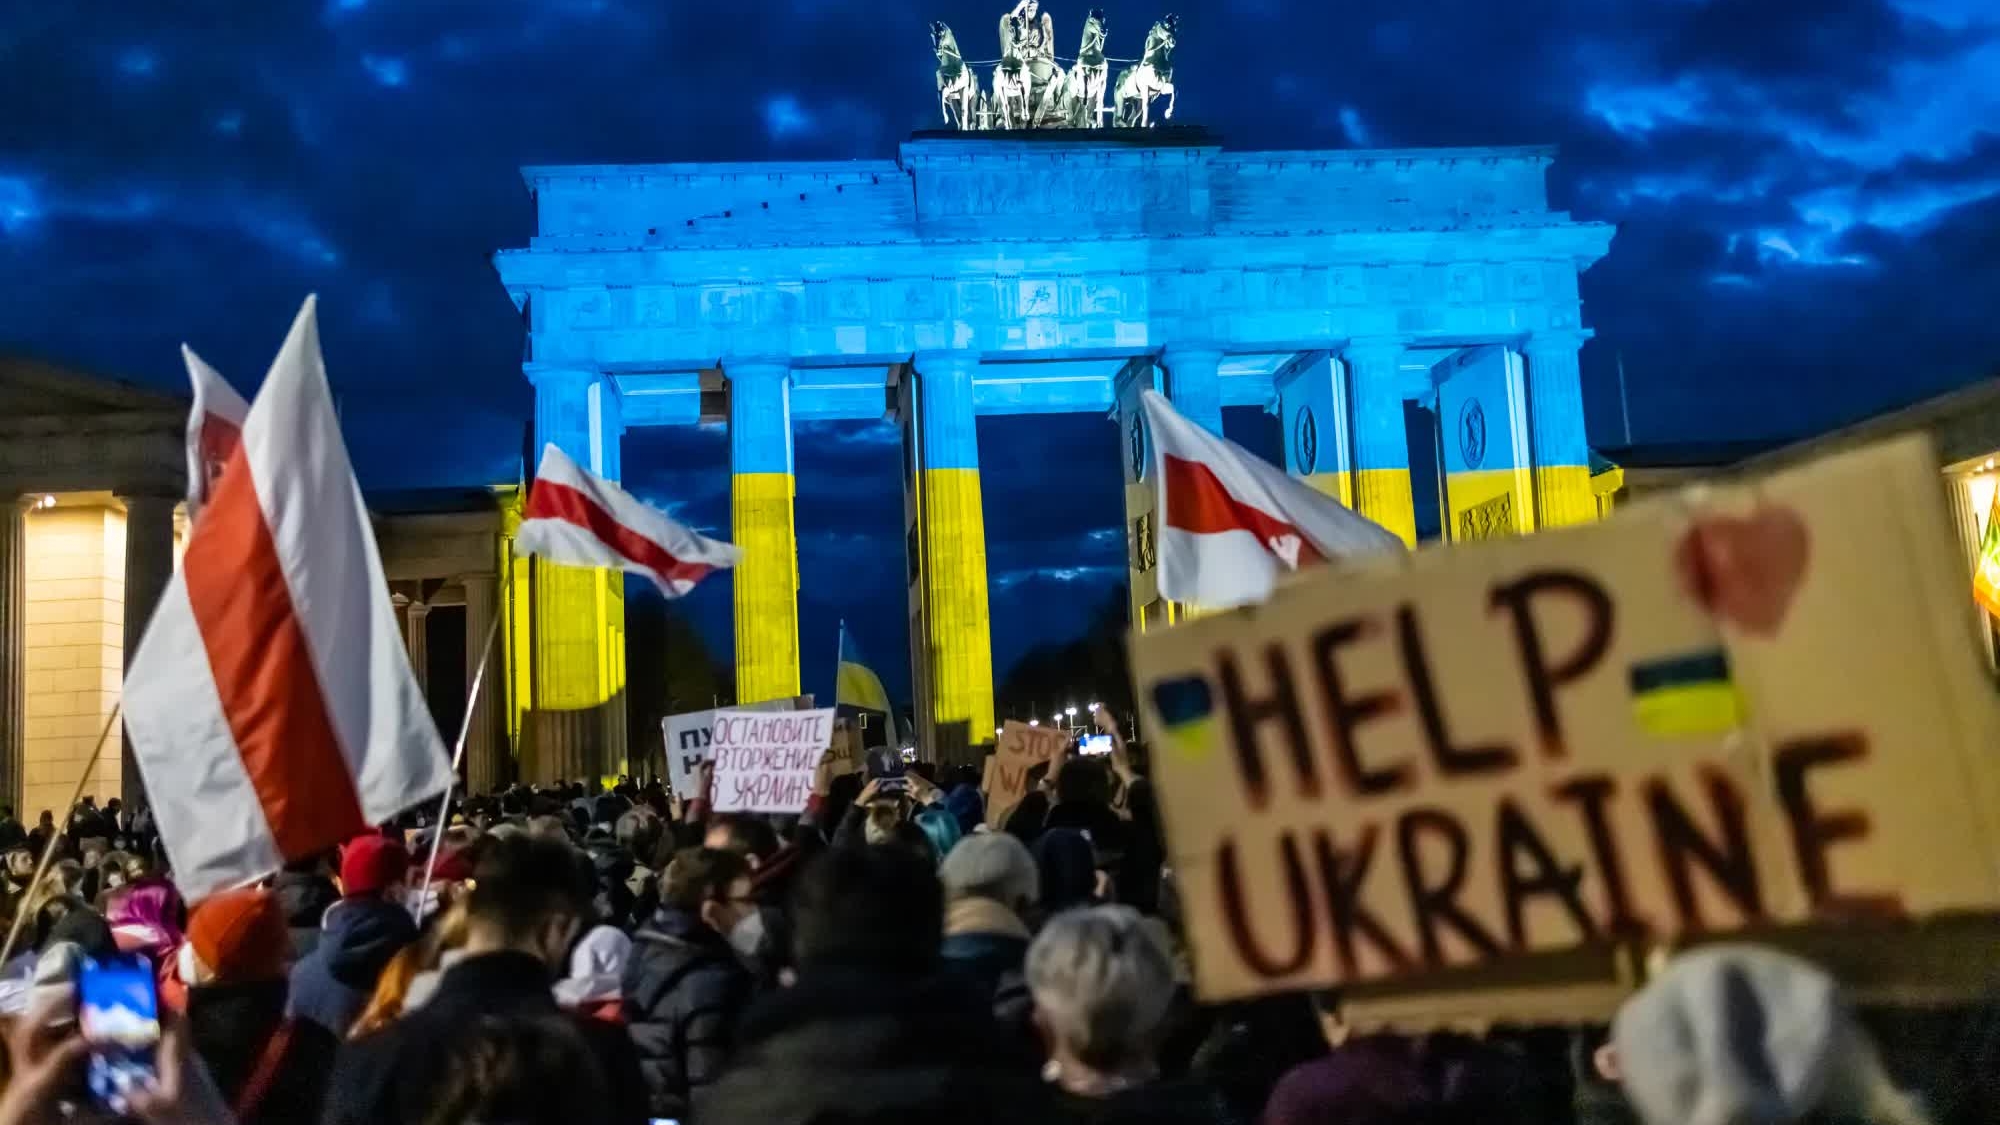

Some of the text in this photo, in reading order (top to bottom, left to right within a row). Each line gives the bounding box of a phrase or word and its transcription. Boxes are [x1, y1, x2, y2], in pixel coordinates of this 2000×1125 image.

[714, 716, 825, 745] ОСТАНОВИТЕ
[1215, 570, 1614, 810] HELP
[715, 745, 821, 771] ВТОРЖЕНИЕ
[1216, 727, 1904, 983] UKRAINE
